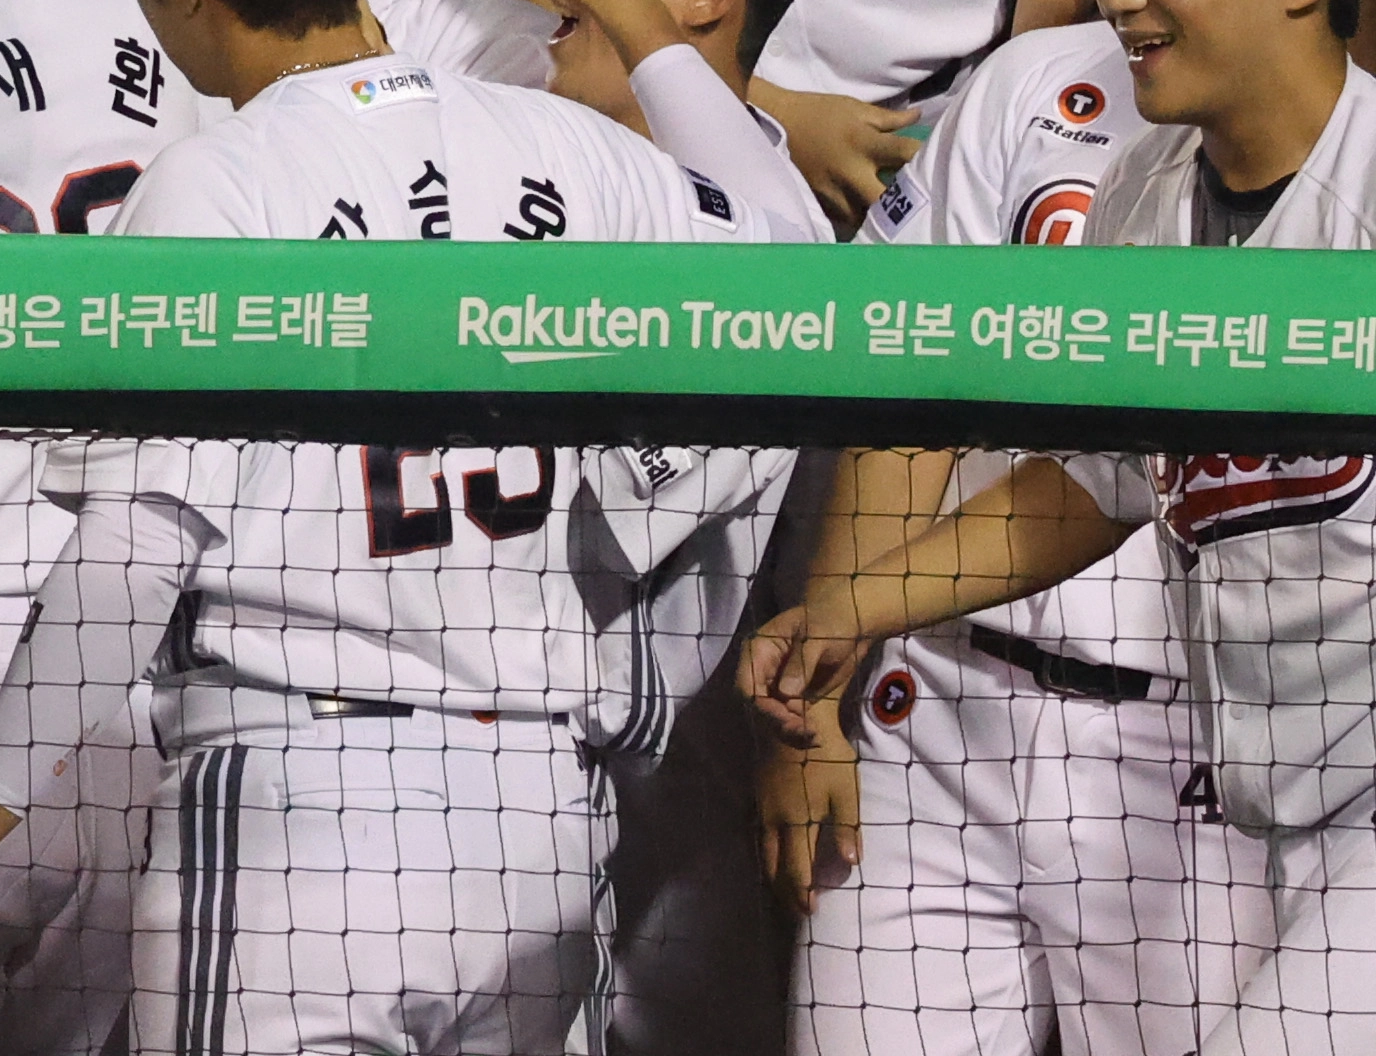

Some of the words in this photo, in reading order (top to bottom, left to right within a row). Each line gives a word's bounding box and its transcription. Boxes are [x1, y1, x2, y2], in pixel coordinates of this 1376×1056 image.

[82, 293, 218, 349] 라쿠텐
[233, 293, 373, 348] 트래블
[458, 295, 671, 348] Rakuten
[682, 302, 837, 352] Travel
[864, 301, 956, 357] 일본
[972, 305, 1112, 363] 여행은
[1128, 311, 1269, 369] 라쿠텐
